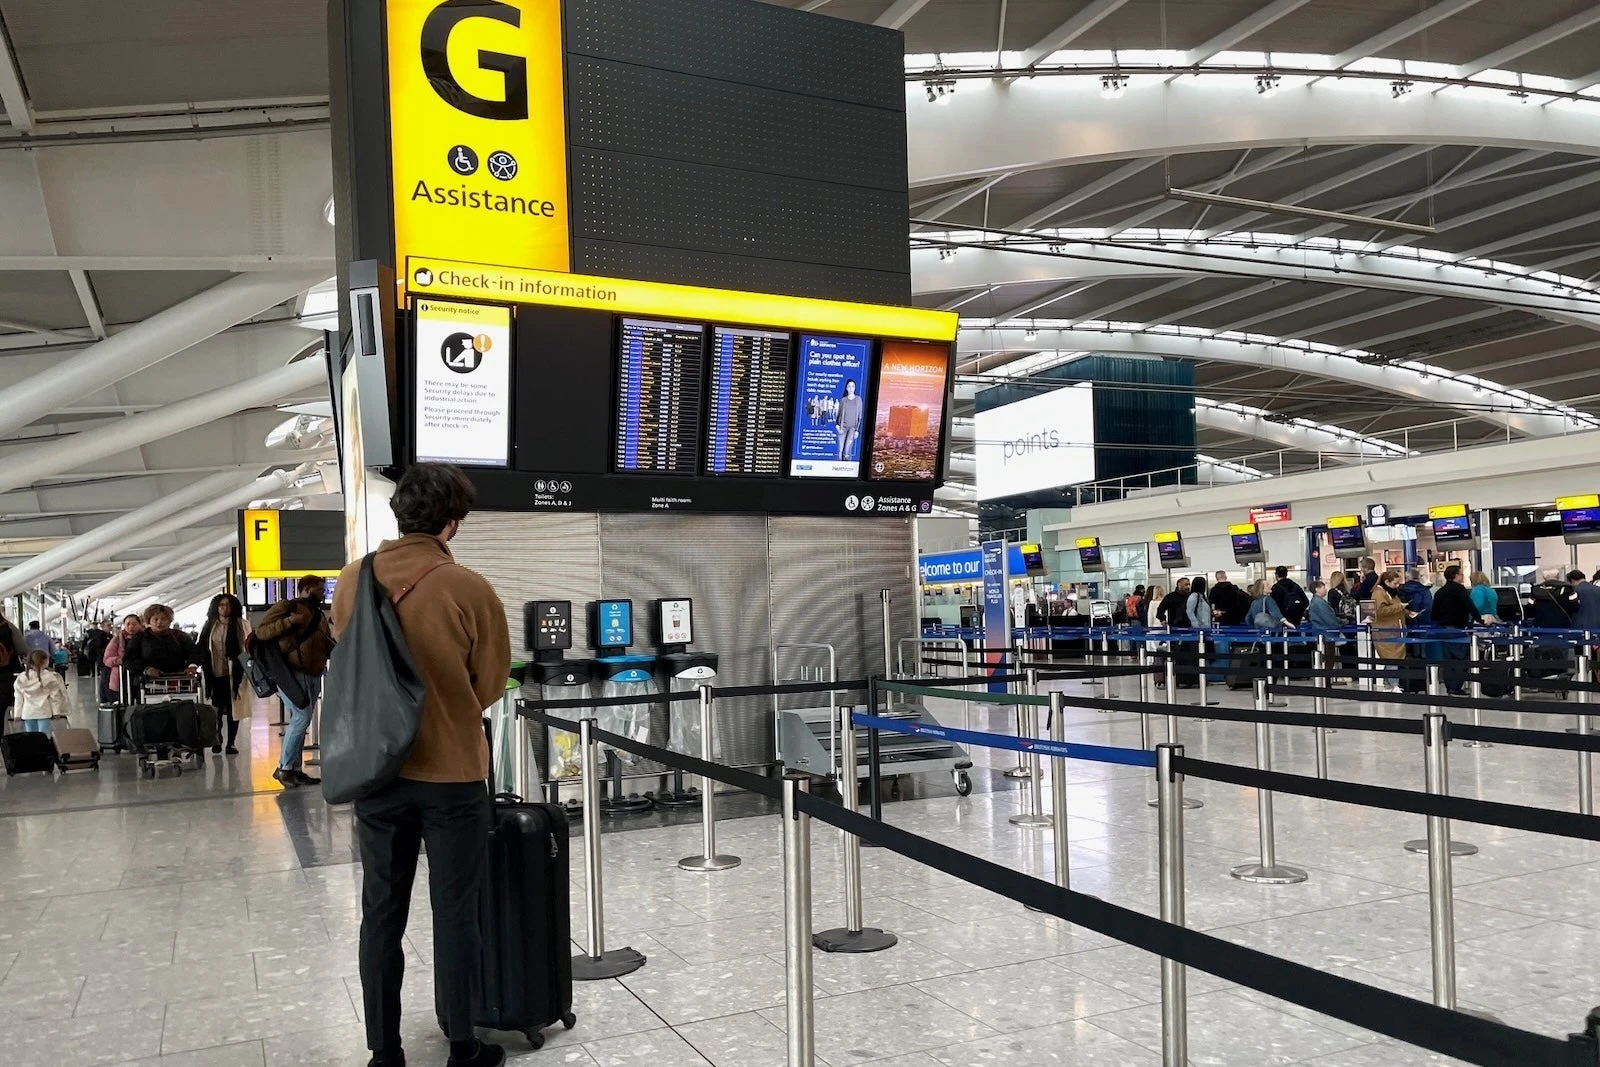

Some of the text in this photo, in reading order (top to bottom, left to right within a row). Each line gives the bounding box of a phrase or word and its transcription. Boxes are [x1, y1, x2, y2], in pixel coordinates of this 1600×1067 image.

[420, 0, 528, 120] G
[411, 180, 555, 218] Assistance
[439, 270, 617, 301] Check-in information
[429, 304, 479, 316] Security notice
[821, 352, 832, 360] you
[833, 352, 845, 361] spot
[808, 358, 861, 368] plain clothes officer?
[908, 364, 943, 373] HORIZON
[424, 379, 443, 387] There
[445, 381, 458, 389] may
[424, 387, 451, 396] Security
[452, 388, 474, 397] delays
[475, 389, 487, 397] due
[424, 395, 456, 403] industrial
[424, 405, 500, 417] Please proceed through
[424, 413, 492, 424] Security immediately
[424, 421, 441, 429] after
[1003, 427, 1059, 466] points
[877, 496, 911, 504] Assistance
[254, 519, 268, 541] F
[919, 560, 980, 578] elcome to our
